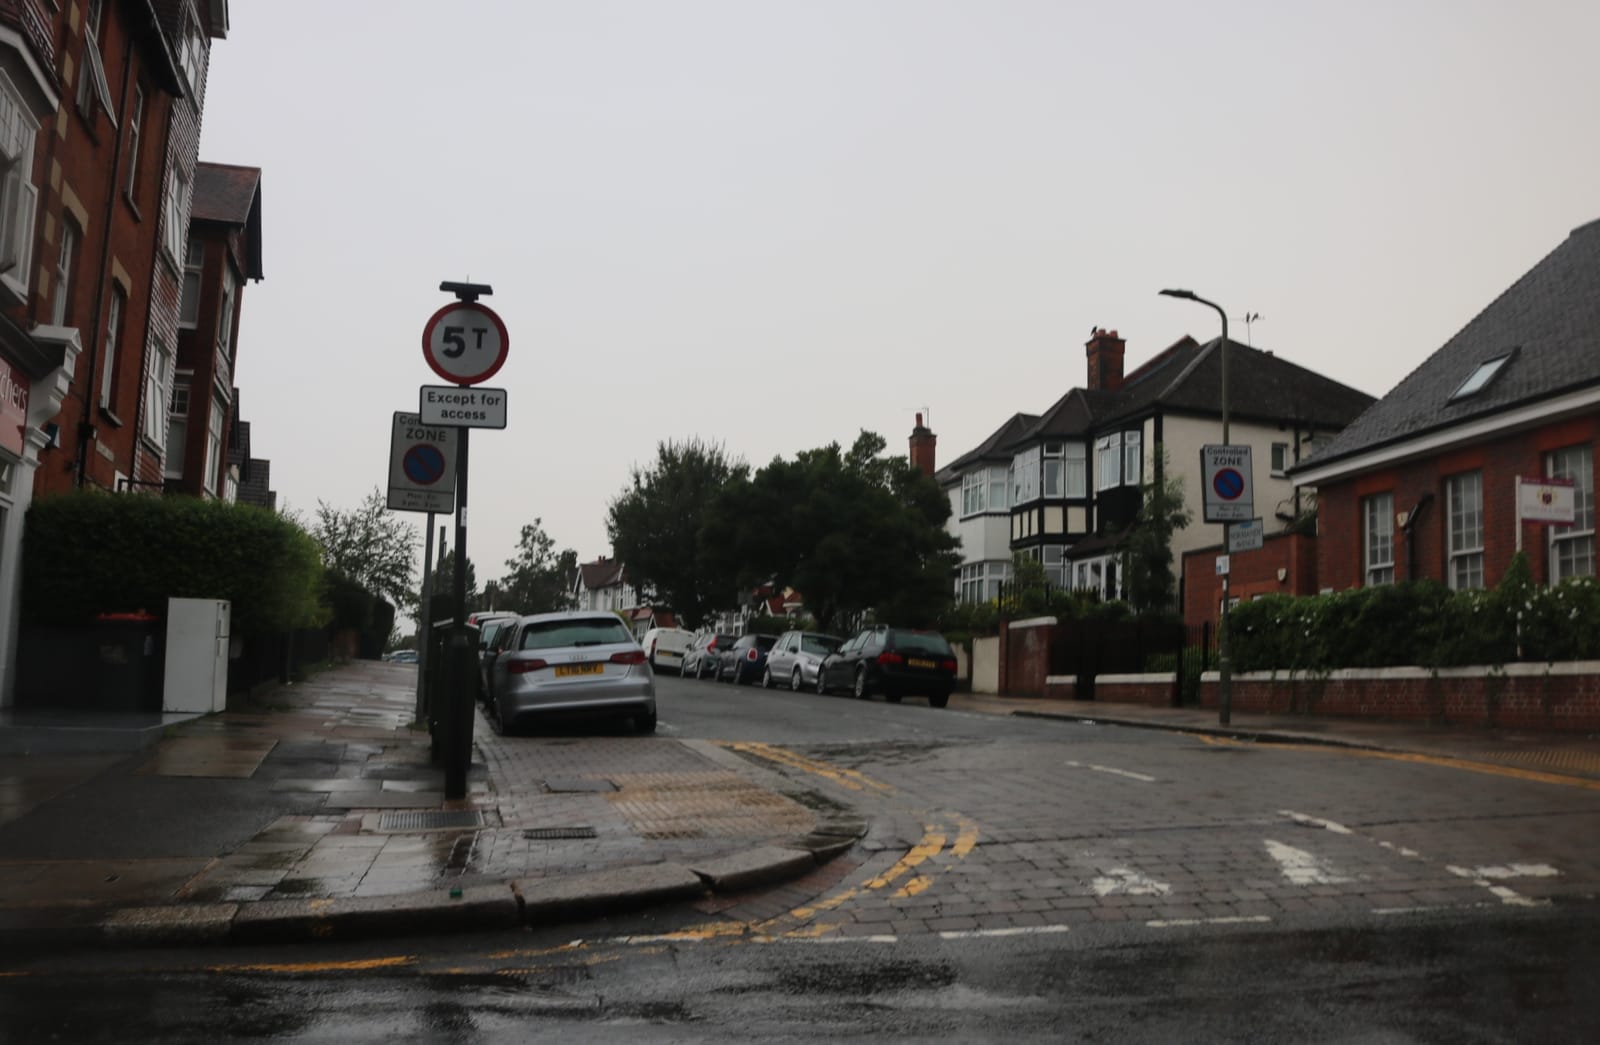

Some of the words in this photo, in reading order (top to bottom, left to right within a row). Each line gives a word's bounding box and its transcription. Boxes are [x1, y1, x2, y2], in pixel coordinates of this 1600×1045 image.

[442, 326, 466, 359] 5
[471, 327, 488, 350] T
[0, 367, 28, 413] chers
[427, 391, 475, 406] Except
[480, 393, 500, 406] for
[399, 415, 420, 425] Con
[440, 408, 487, 421] access
[405, 427, 447, 442] ZONE
[1206, 446, 1249, 456] Controlled
[1212, 456, 1243, 467] ZONE
